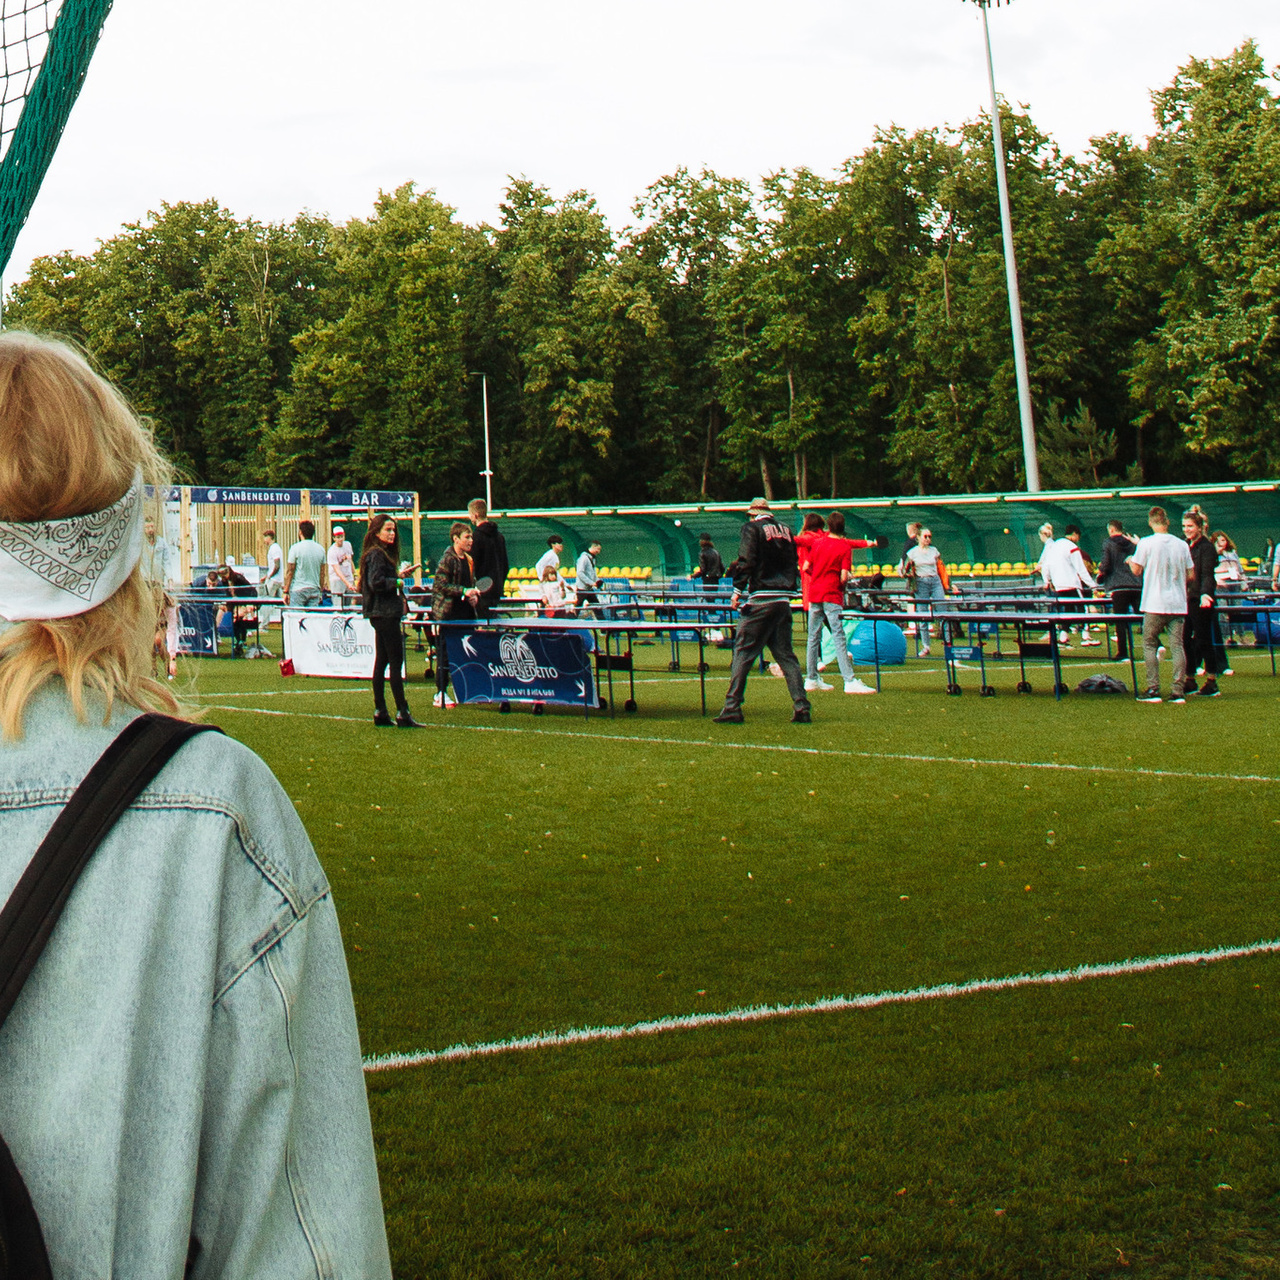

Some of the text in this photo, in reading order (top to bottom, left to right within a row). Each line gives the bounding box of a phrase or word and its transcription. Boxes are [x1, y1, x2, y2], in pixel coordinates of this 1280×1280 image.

[222, 490, 291, 502] SANBENEDETTO
[352, 492, 380, 506] BAR
[488, 662, 559, 680] SANBENEDETTO
